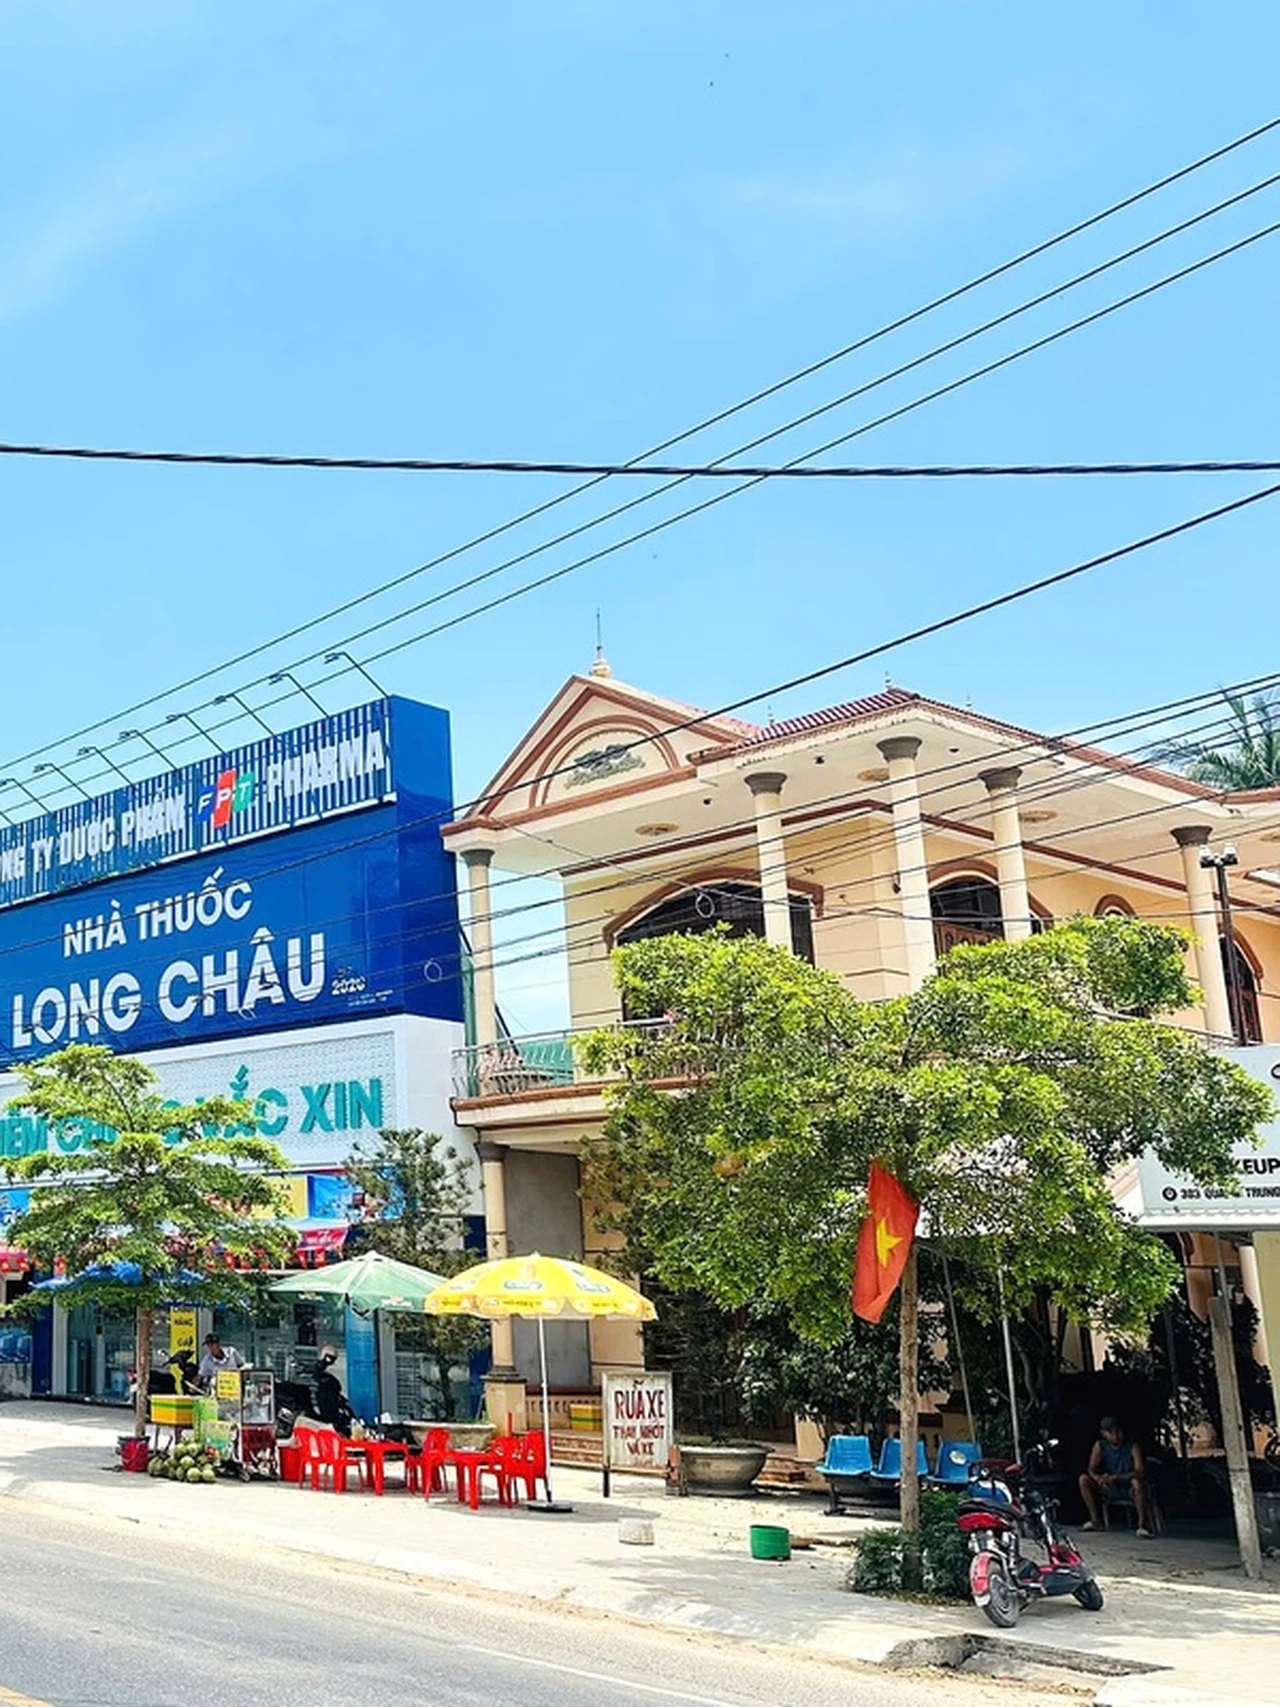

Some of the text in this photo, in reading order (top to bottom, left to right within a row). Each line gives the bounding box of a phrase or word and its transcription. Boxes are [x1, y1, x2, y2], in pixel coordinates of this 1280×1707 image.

[32, 836, 54, 873] TY
[266, 730, 385, 803] PHARMA
[63, 867, 252, 957] NHÀ THUỐC
[12, 927, 325, 1049] LONG CHÂU
[300, 1079, 384, 1133] XIN
[1234, 1157, 1280, 1175] EUP
